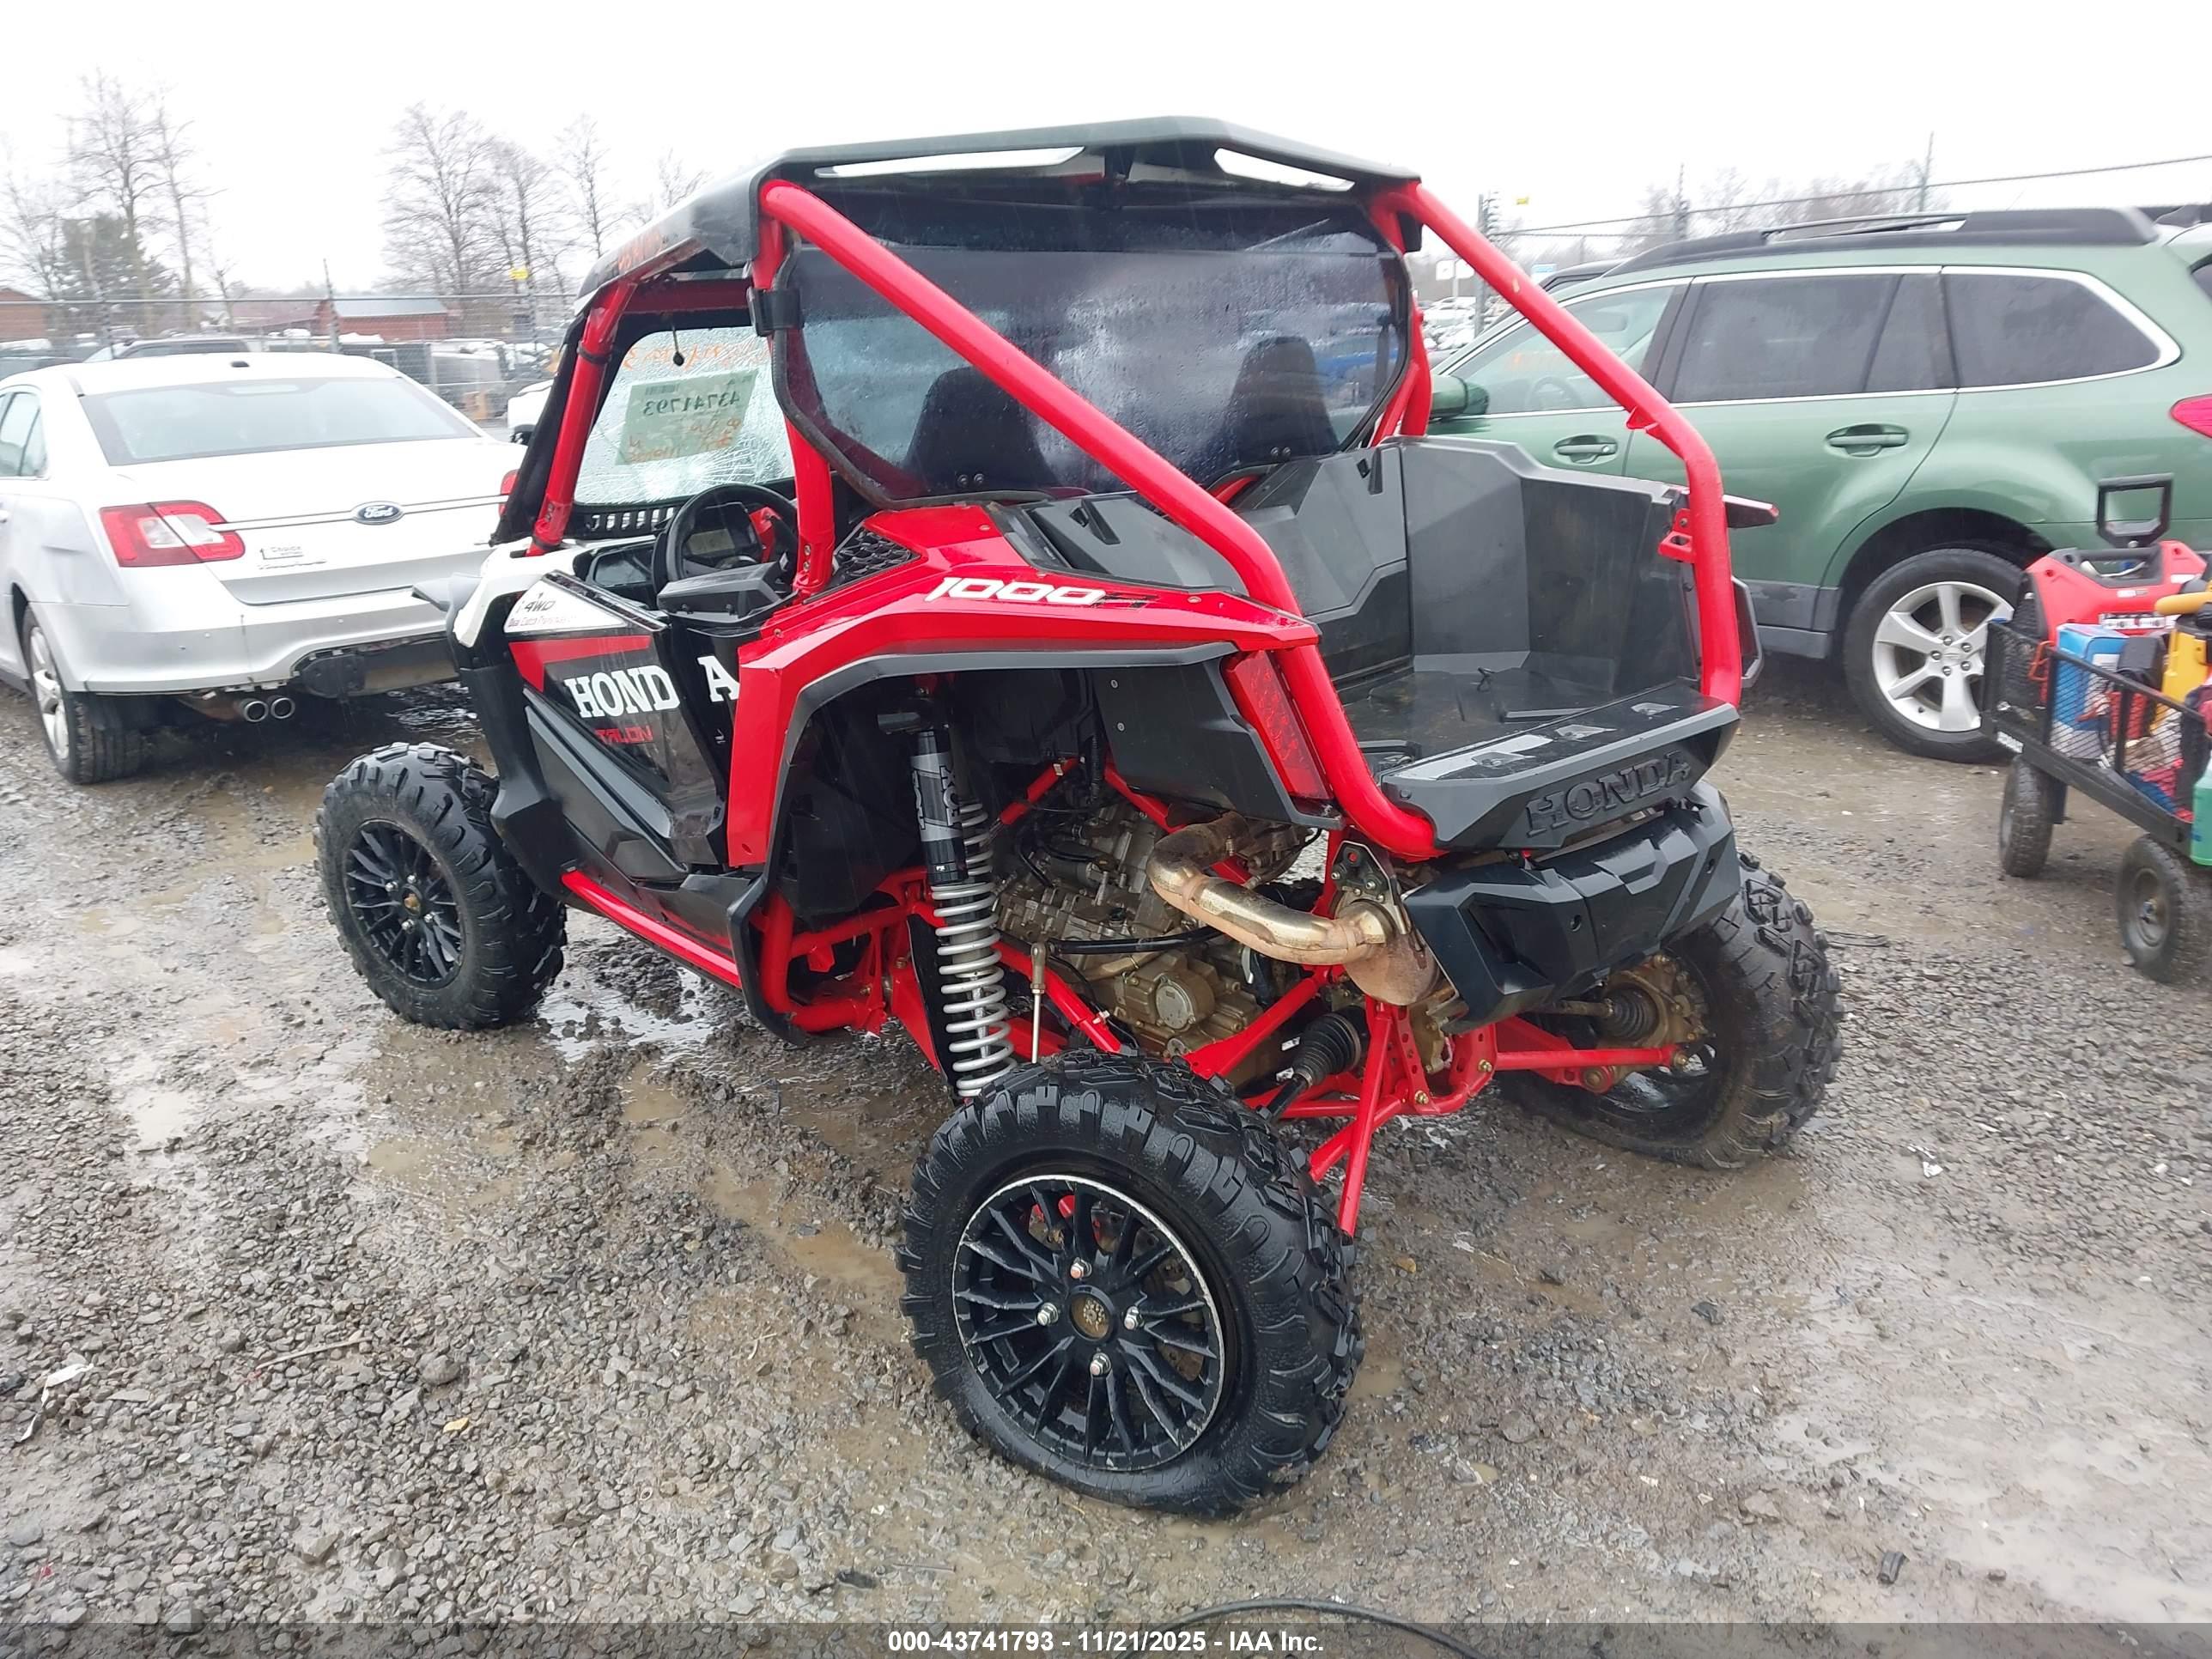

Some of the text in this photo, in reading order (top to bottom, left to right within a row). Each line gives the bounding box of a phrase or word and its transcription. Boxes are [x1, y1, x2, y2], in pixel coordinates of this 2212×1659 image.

[363, 505, 395, 519] Ford
[595, 726, 653, 744] TALON
[1525, 750, 1692, 838] HONDA
